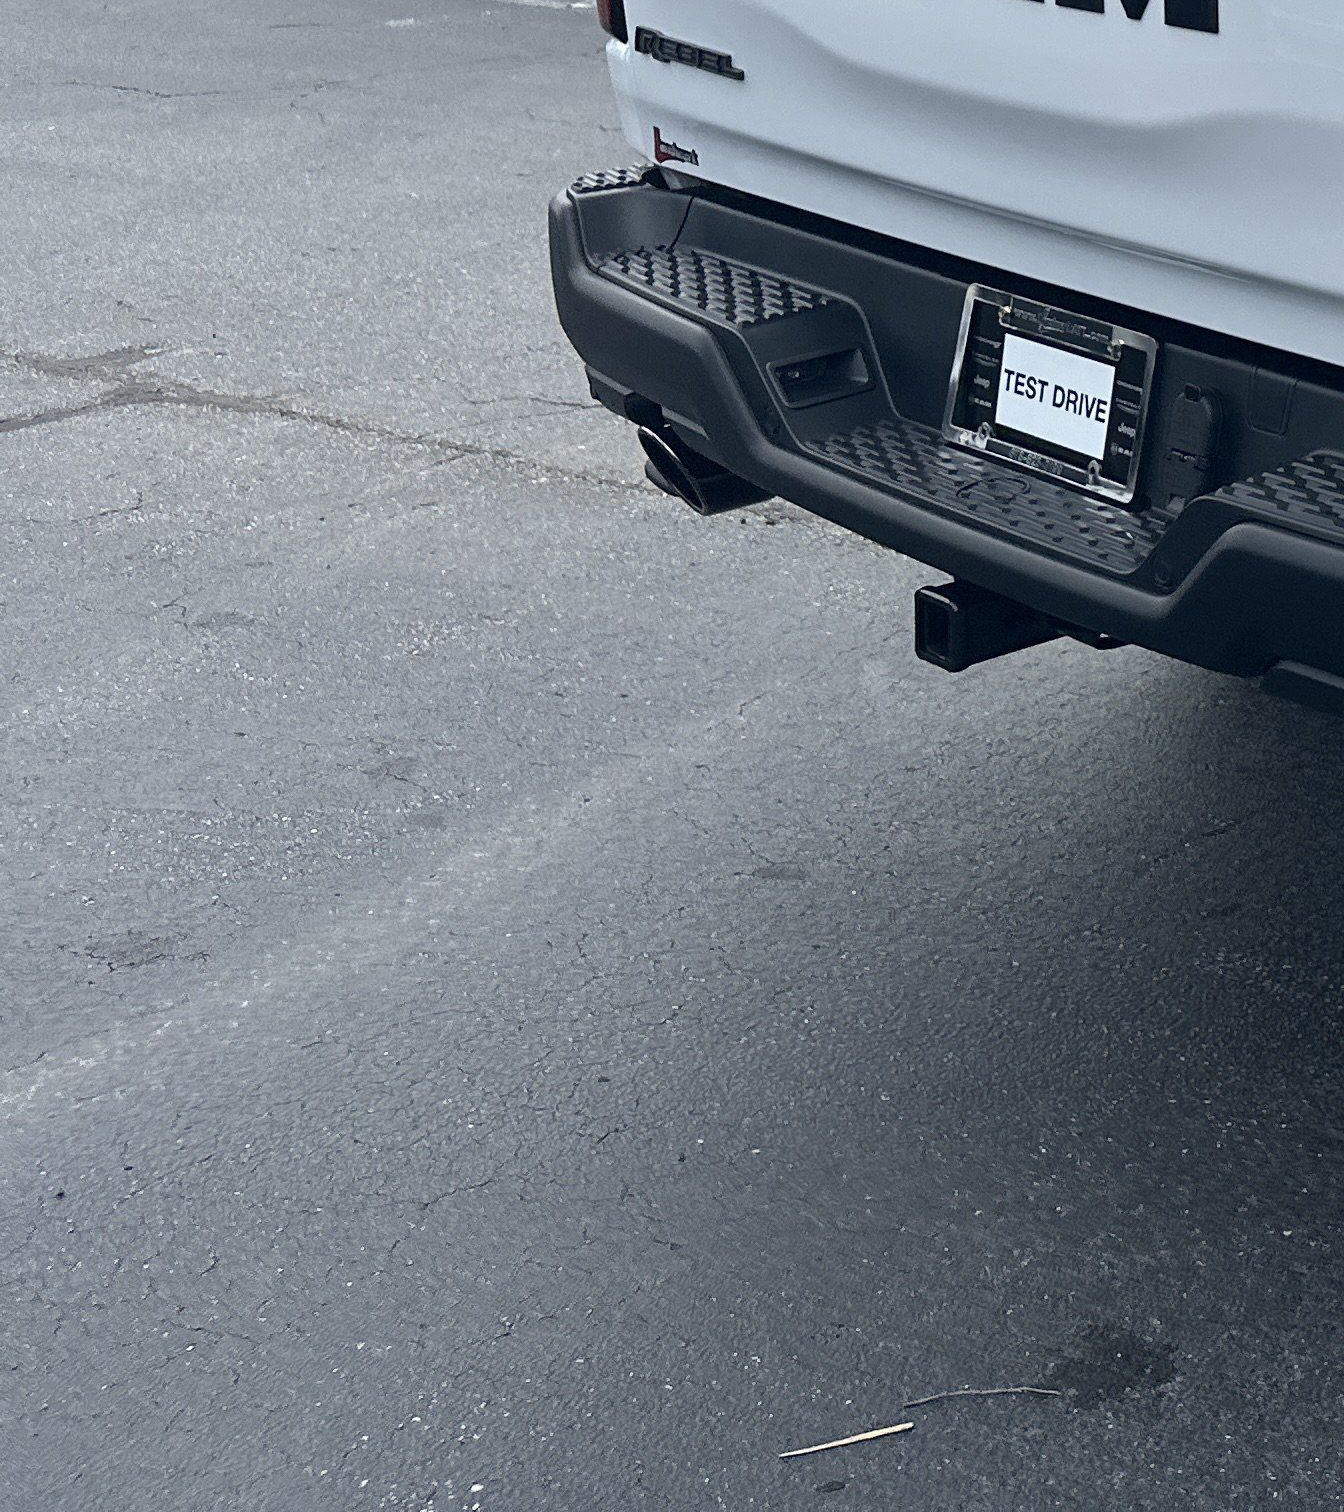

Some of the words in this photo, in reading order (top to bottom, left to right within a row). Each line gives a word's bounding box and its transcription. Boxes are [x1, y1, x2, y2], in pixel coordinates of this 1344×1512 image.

[635, 25, 745, 81] REBEL
[1004, 368, 1049, 403] TEST
[1052, 384, 1108, 423] DRIVE
